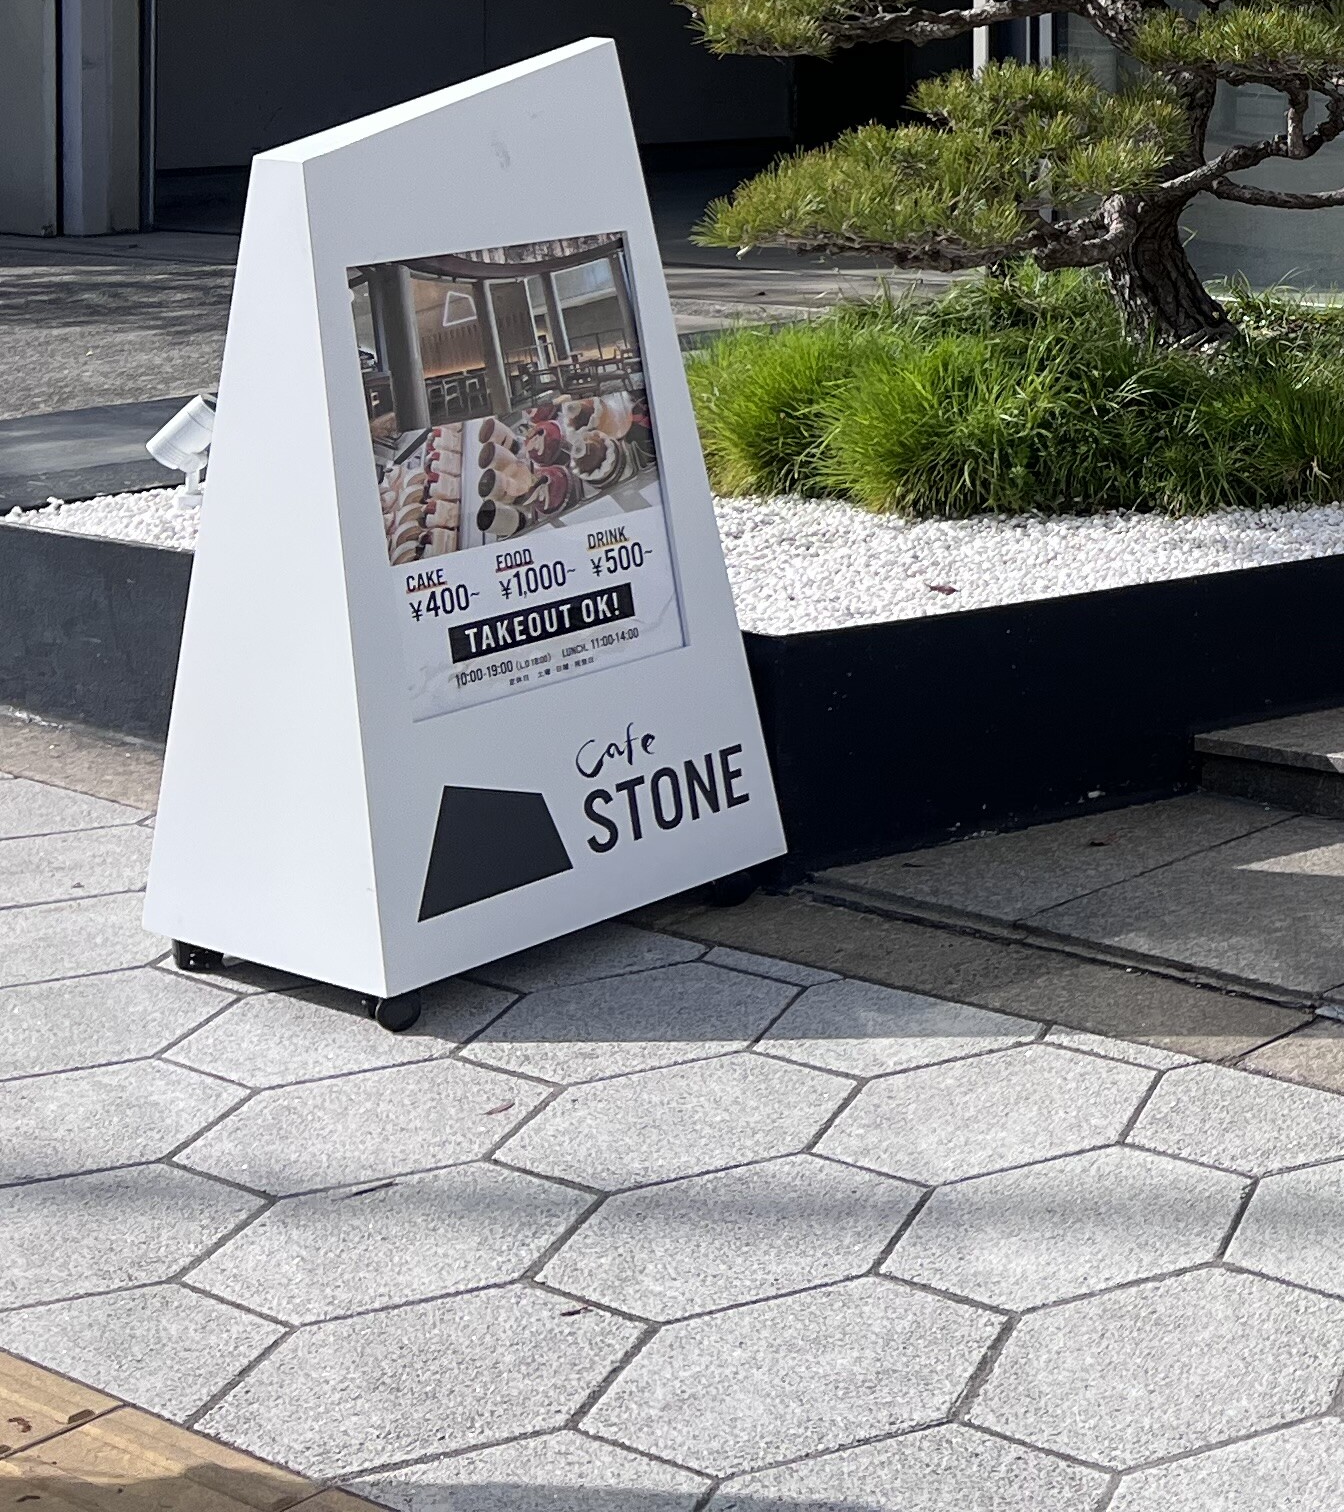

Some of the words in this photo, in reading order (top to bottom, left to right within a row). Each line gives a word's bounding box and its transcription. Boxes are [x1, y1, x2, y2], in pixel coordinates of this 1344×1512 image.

[587, 526, 628, 549] DRINK
[496, 549, 532, 570] FOOD
[406, 568, 444, 592] CAKE
[464, 605, 571, 654] TAKEOUT
[581, 592, 620, 623] OK!
[455, 660, 514, 688] 10:00-19:00
[575, 721, 656, 779] Cafe
[583, 743, 750, 853] STONE
